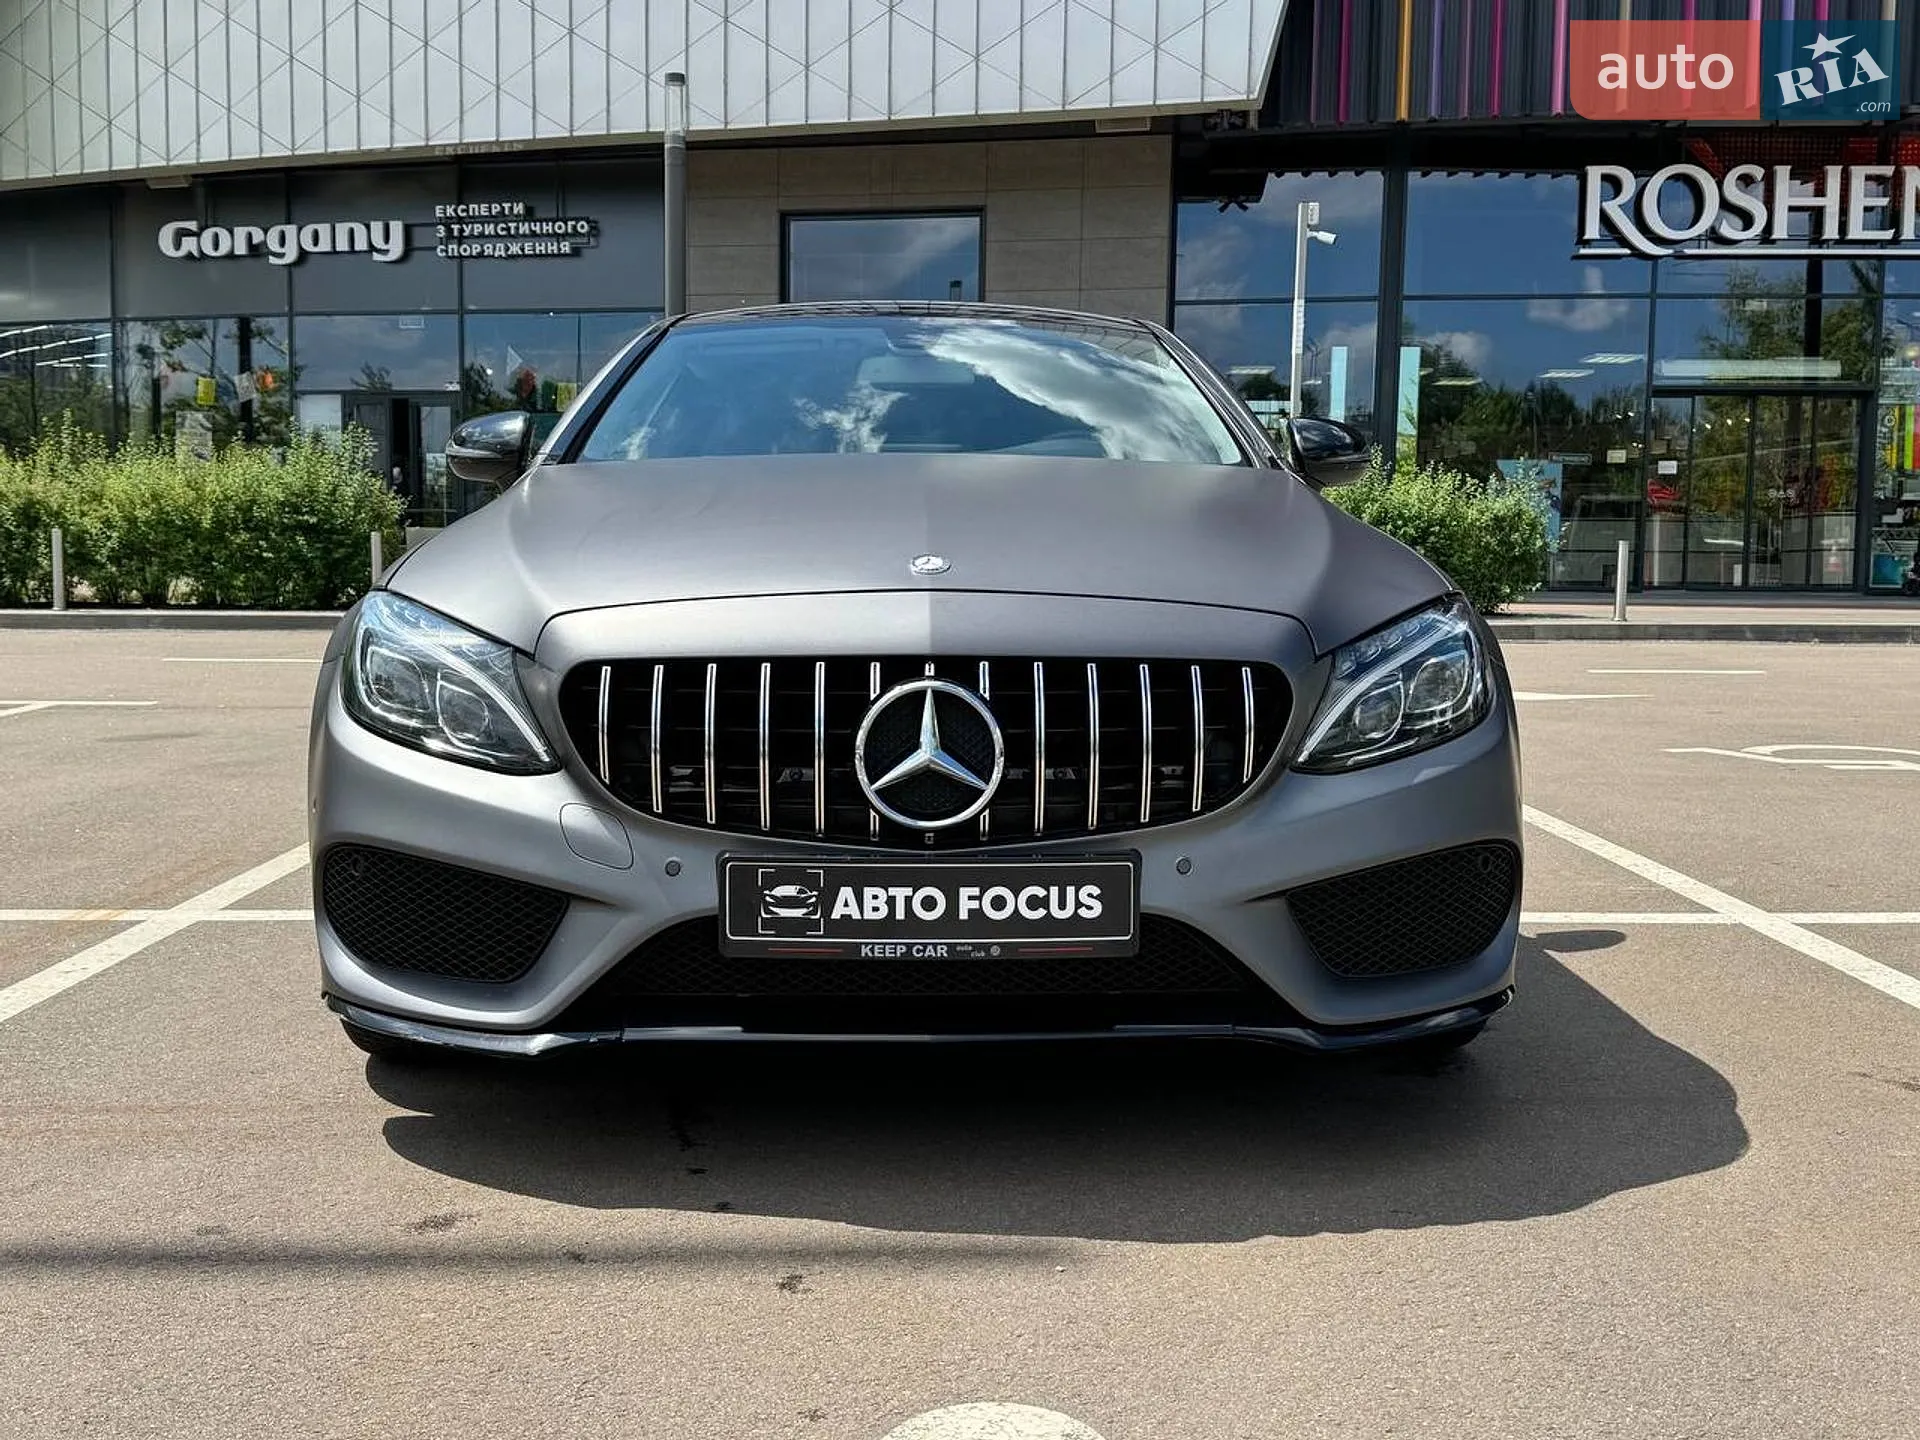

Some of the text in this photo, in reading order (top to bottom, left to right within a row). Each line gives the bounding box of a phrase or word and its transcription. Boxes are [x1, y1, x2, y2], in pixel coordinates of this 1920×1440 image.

[435, 202, 525, 217] ЕКСПЕРТИ
[1583, 163, 1920, 255] ROSHE
[451, 220, 589, 237] ТУРИСТИЧНОГО
[158, 219, 405, 266] Gorgany
[436, 241, 571, 257] СПОРЯДЖЕННЯ
[958, 885, 1103, 920] FOCUS
[860, 944, 949, 957] KEEP CAR
